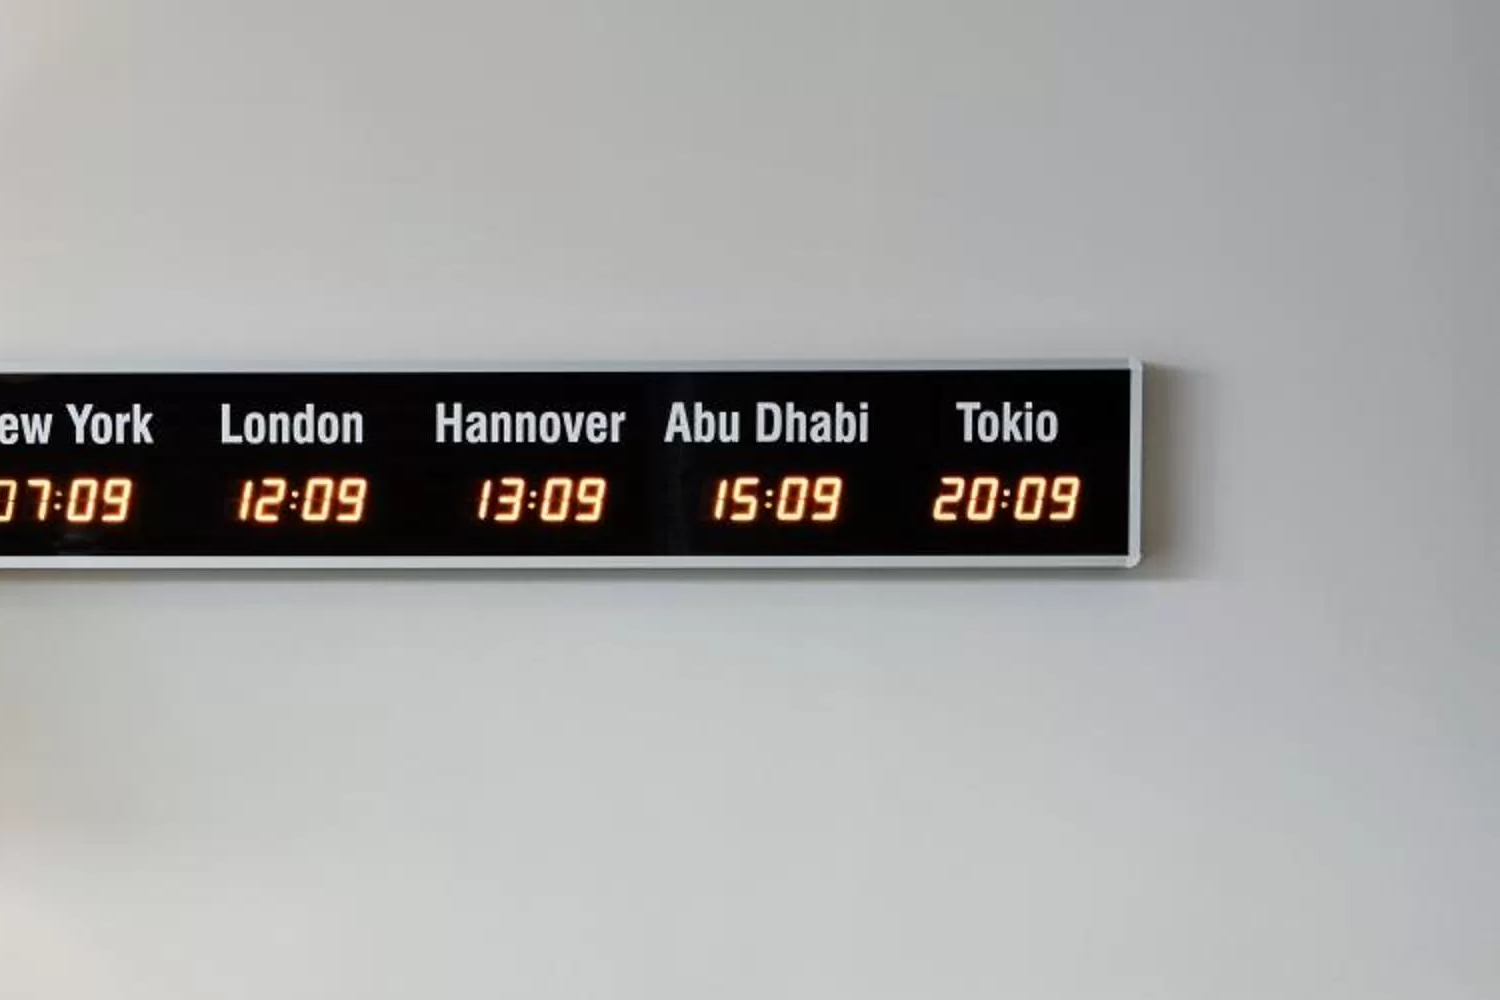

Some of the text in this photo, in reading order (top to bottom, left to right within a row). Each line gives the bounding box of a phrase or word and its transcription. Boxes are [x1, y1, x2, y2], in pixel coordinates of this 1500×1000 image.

[66, 403, 154, 445] York
[221, 403, 363, 445] London
[435, 402, 626, 444] Hannover
[663, 401, 869, 443] Abu Dhabi
[955, 401, 1059, 443] Tokio
[238, 478, 368, 522] 12:09
[477, 477, 607, 522] 13:09
[713, 477, 843, 521] 15:09
[932, 476, 1081, 521] 20:09
